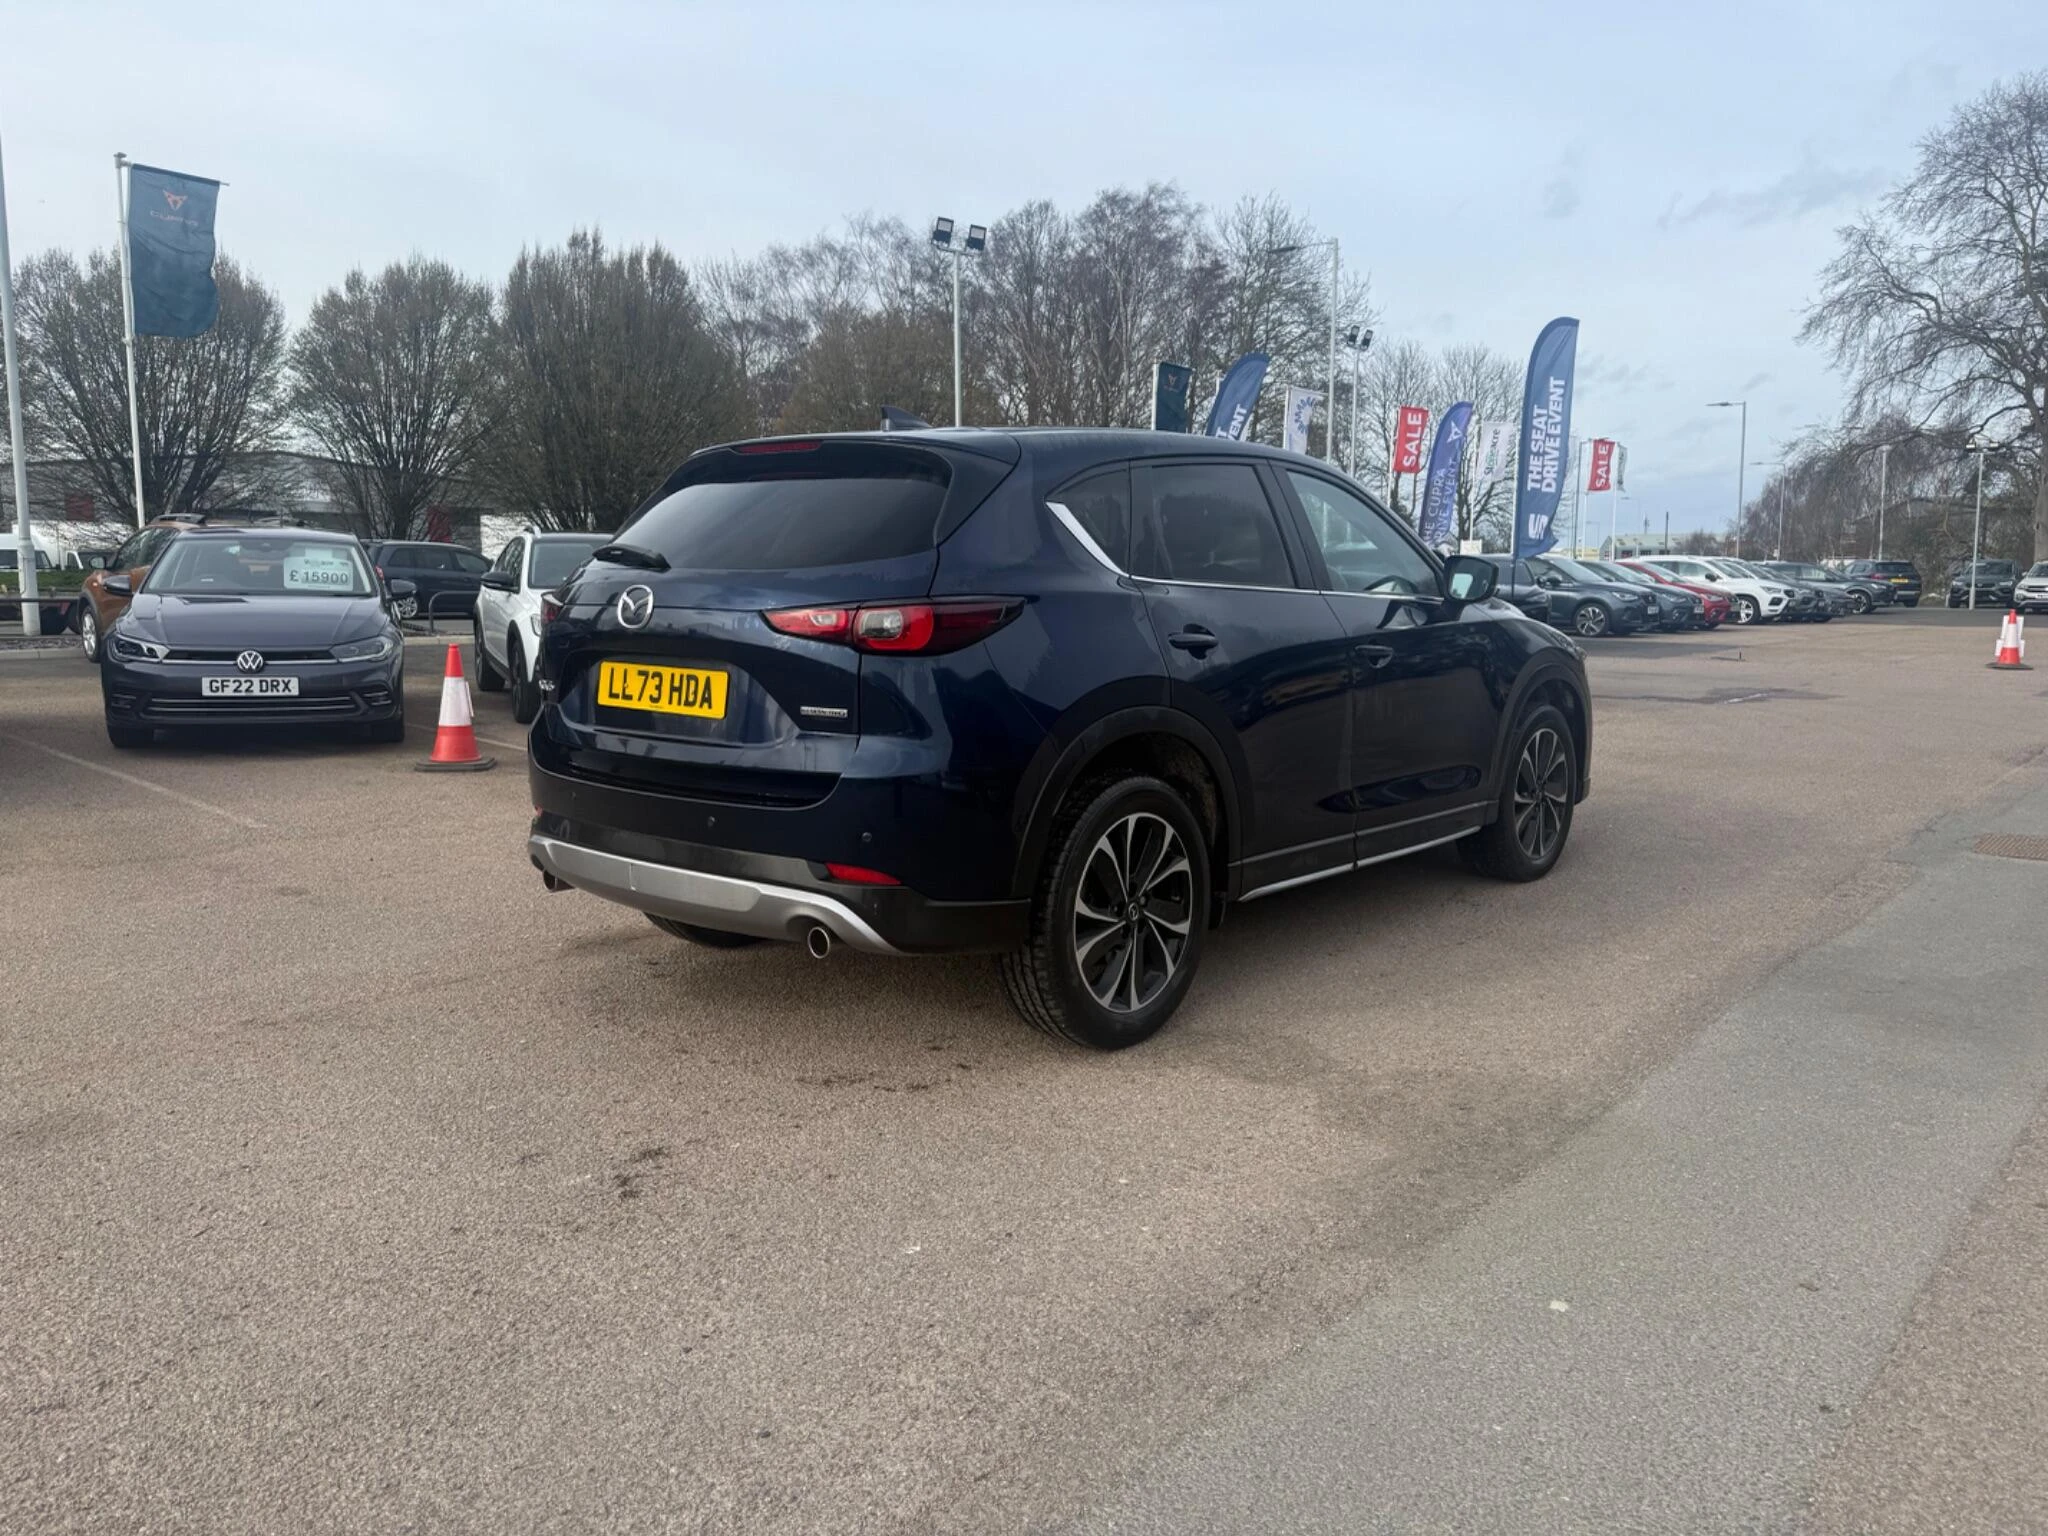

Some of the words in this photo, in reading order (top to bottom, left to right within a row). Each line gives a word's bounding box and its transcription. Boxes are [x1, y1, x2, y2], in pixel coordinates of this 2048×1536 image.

[1531, 404, 1548, 453] SEAT
[1548, 376, 1565, 436] EVENT
[1402, 412, 1422, 467] SALE
[1527, 456, 1543, 491] THE
[1541, 438, 1561, 493] DRIVE
[1595, 443, 1610, 488] SALE
[1427, 468, 1446, 517] CUPRA
[1434, 509, 1450, 540] RIVE
[1443, 456, 1457, 505] EVENT
[303, 571, 349, 584] 15900
[209, 679, 254, 693] GF22
[259, 679, 292, 693] DRX
[608, 667, 663, 704] LL73
[668, 672, 712, 709] HDA
